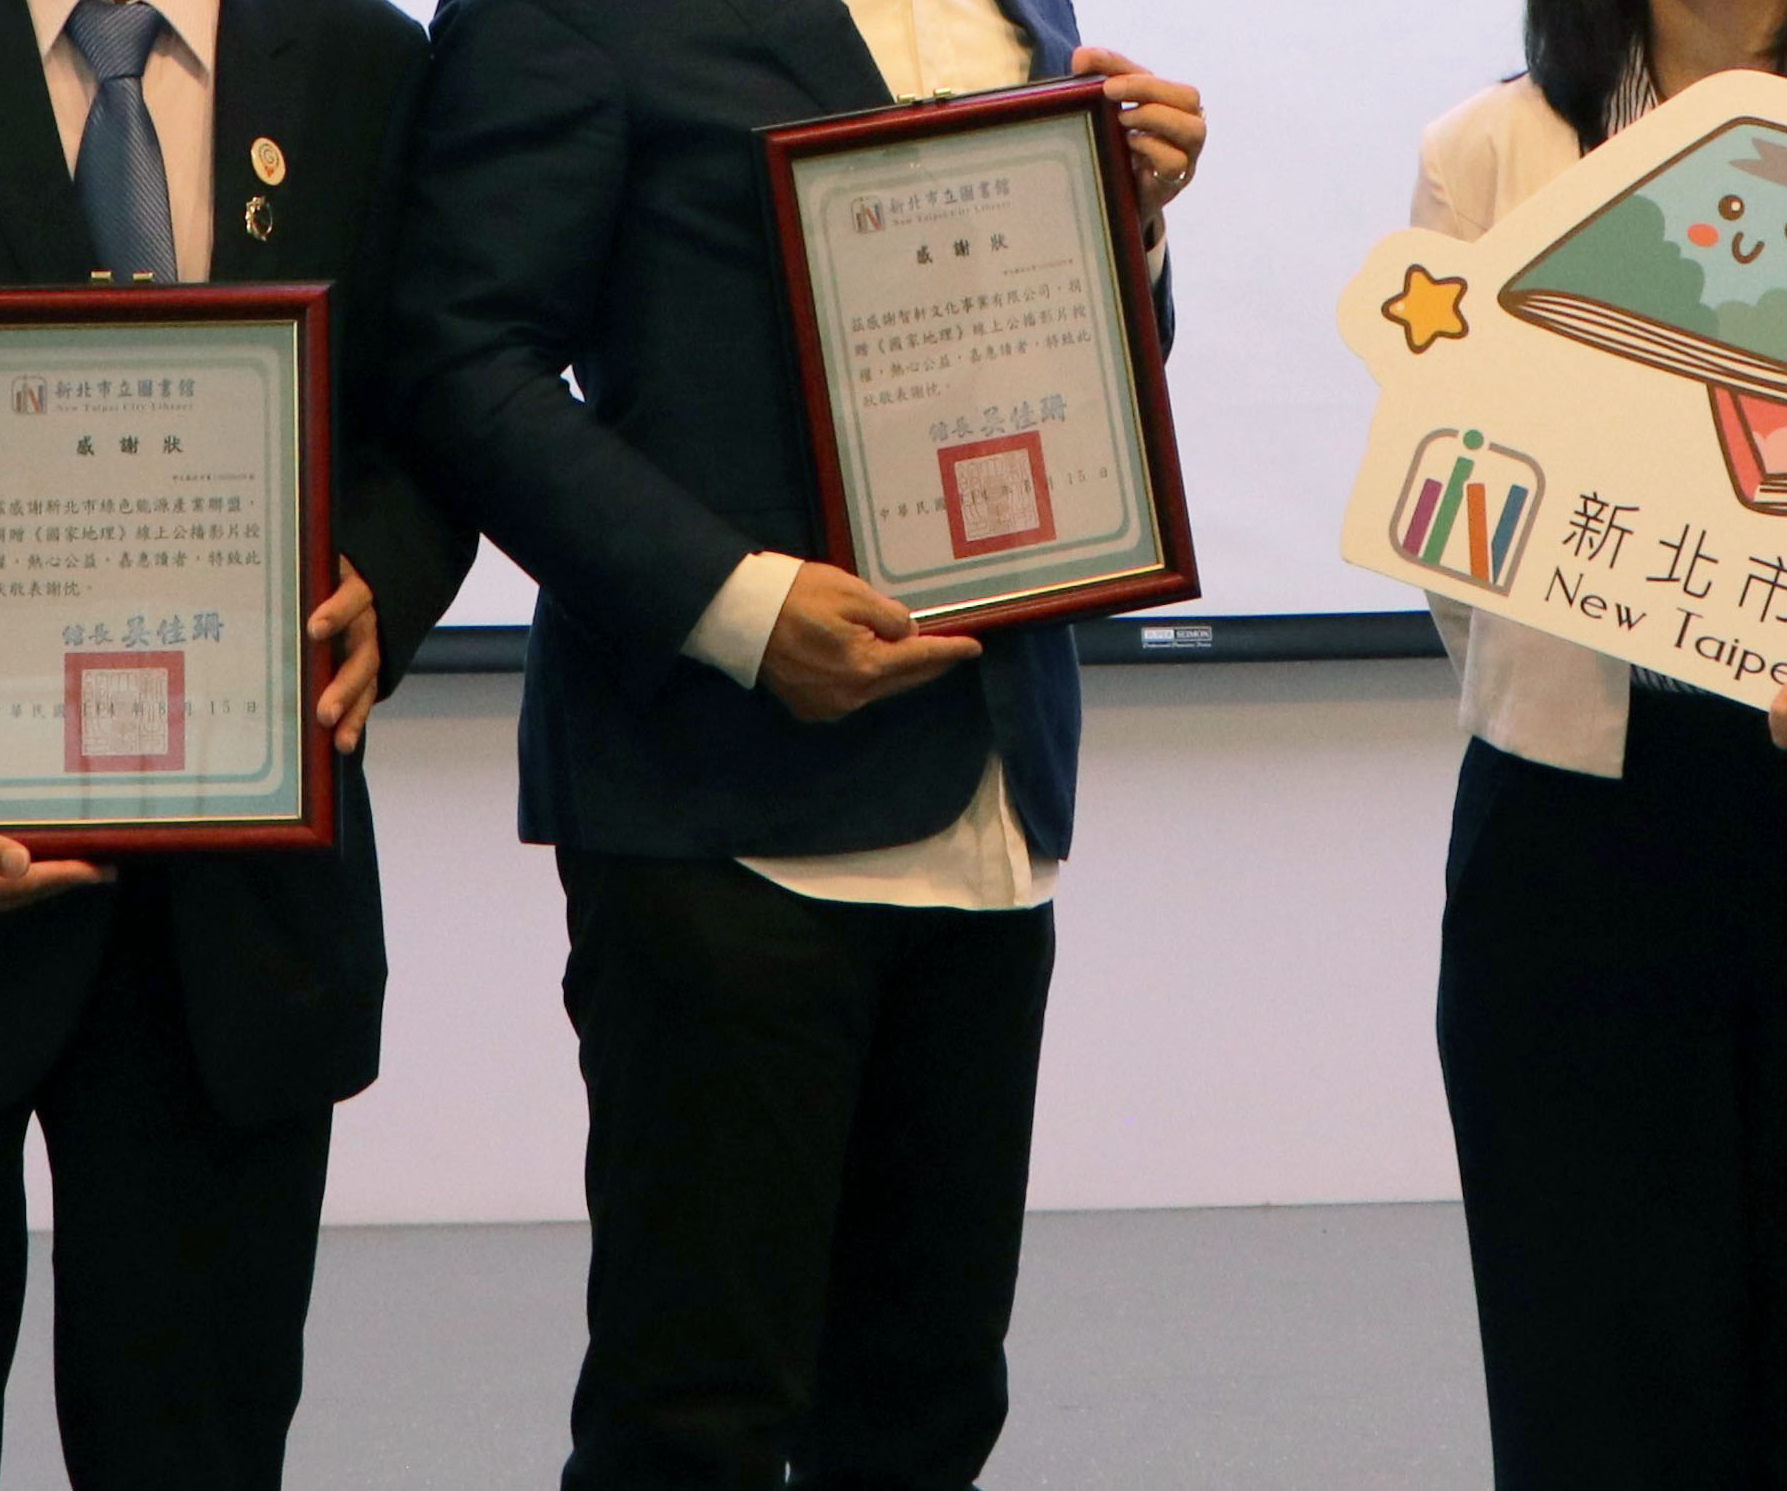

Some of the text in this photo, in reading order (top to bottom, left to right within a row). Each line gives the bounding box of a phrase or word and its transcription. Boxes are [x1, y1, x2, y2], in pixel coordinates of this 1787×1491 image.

[917, 233, 1009, 265] 感謝狀
[55, 378, 196, 399] 新北市立圖書館
[77, 435, 183, 457] 感謝狀
[1545, 566, 1647, 631] New
